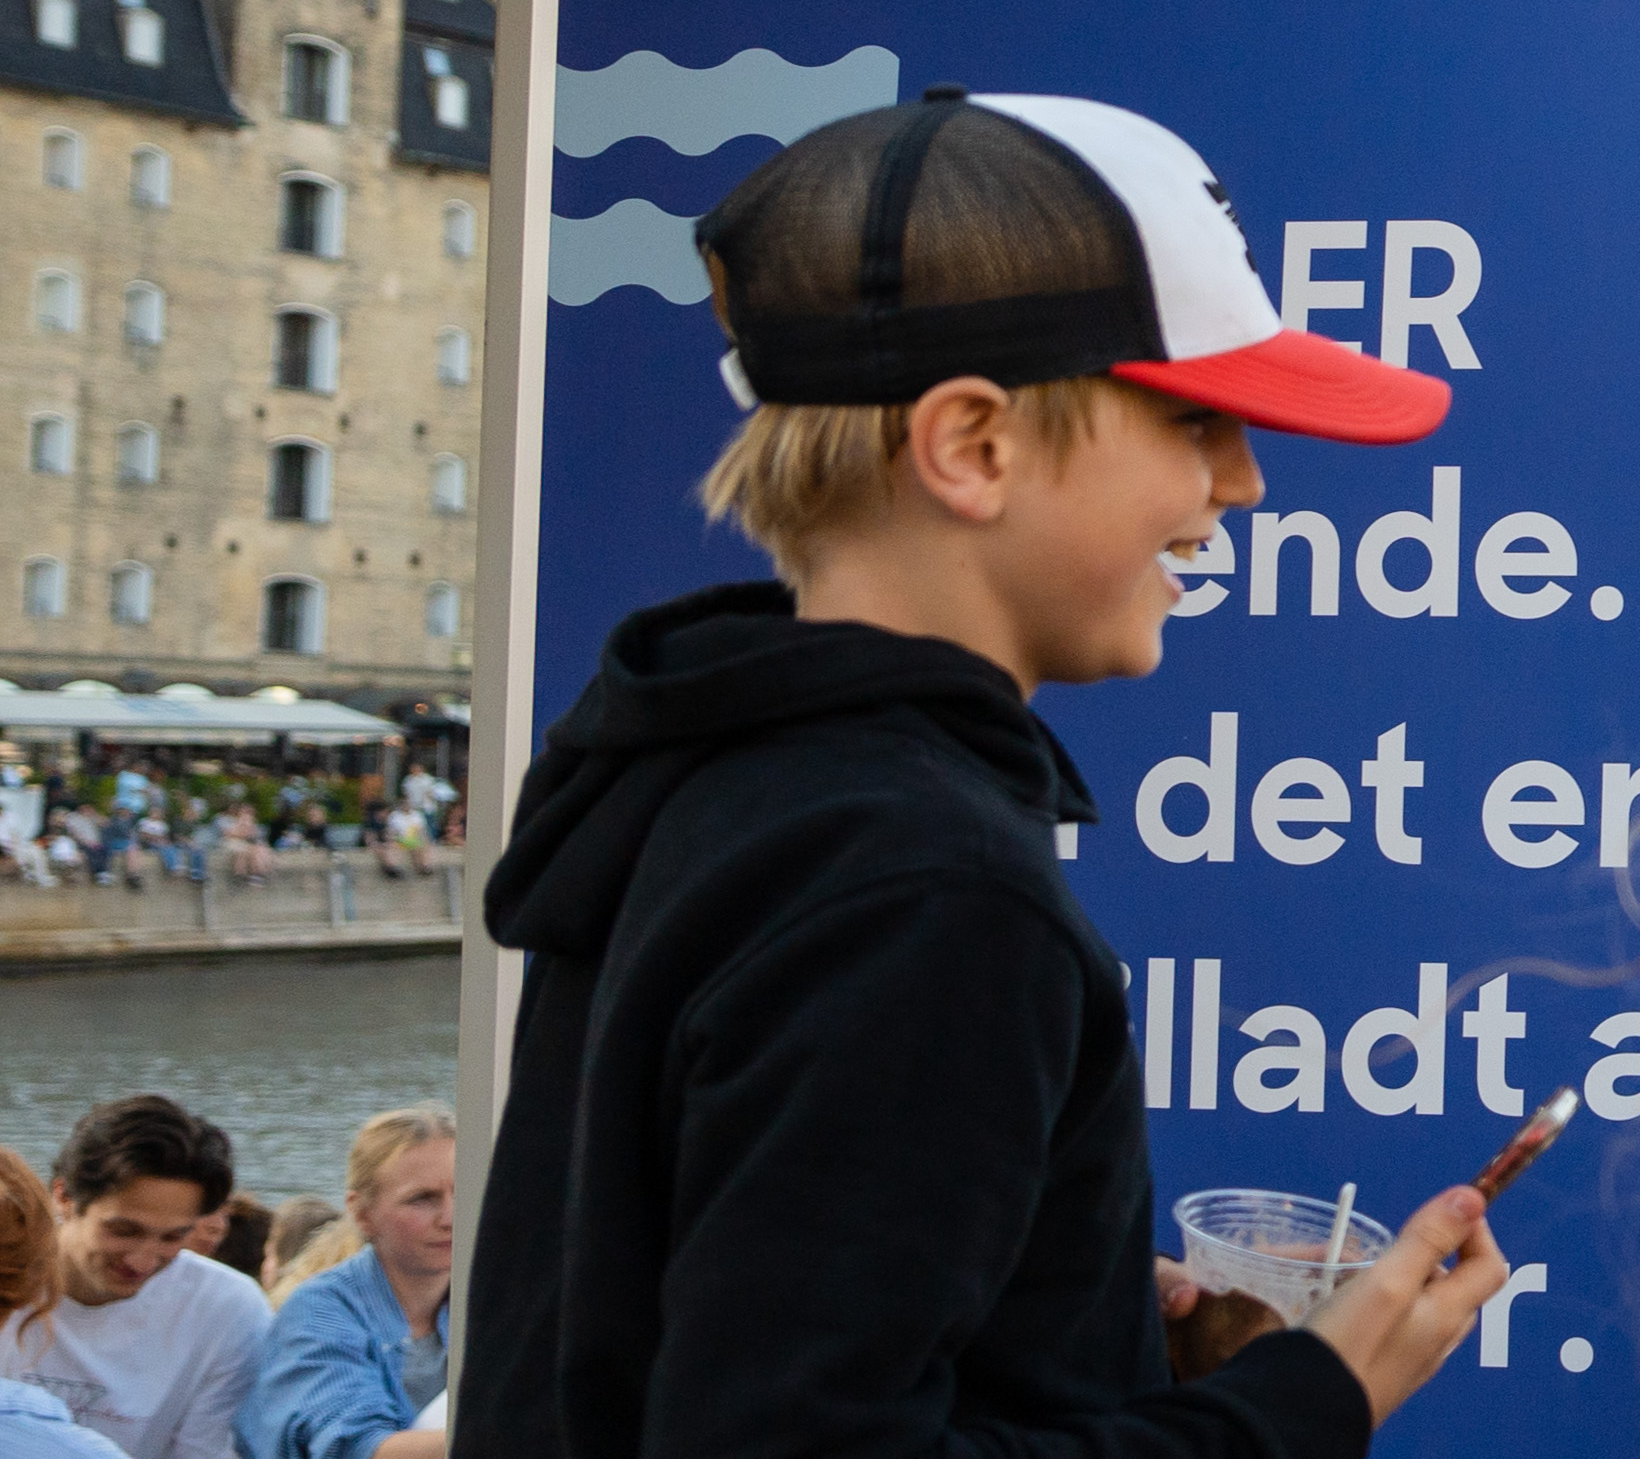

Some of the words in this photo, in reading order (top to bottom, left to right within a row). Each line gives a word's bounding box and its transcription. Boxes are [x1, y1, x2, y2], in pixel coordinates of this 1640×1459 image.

[1280, 219, 1483, 370] ER
[1134, 711, 1425, 865] det
[1119, 956, 1527, 1118] lladt
